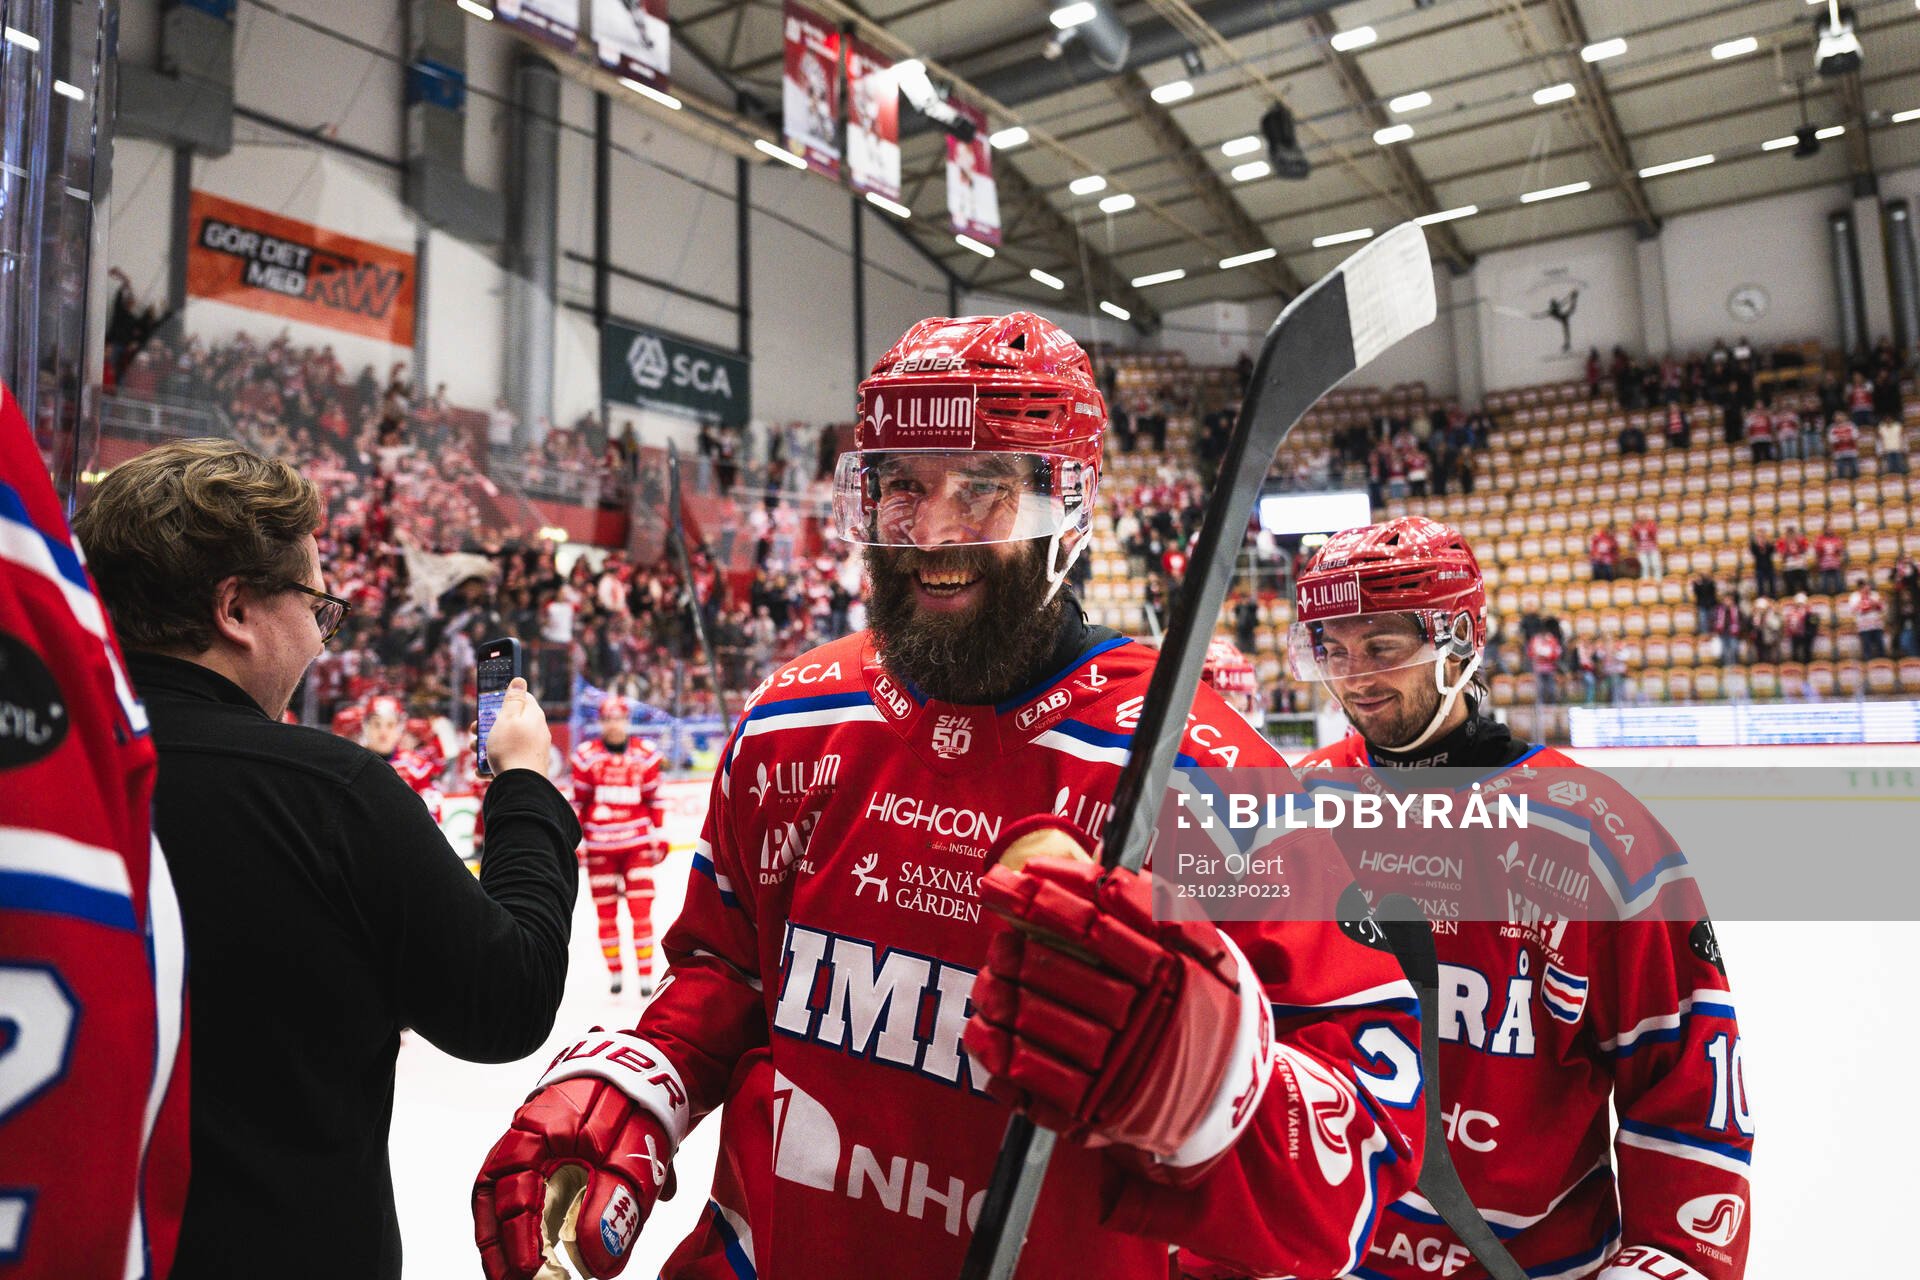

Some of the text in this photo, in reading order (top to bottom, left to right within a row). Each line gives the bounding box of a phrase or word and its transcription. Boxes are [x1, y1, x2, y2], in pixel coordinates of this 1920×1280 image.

[260, 237, 311, 269] DET
[246, 260, 306, 296] MED
[671, 353, 733, 399] SCA
[896, 396, 972, 429] LILIUM
[1312, 581, 1358, 606] LILIUM
[777, 661, 842, 688] SCA
[875, 676, 910, 717] EAB
[1019, 691, 1068, 729] EAB
[935, 714, 974, 731] SHL
[931, 727, 972, 755] 50
[865, 791, 1003, 844] HIGHCON
[1588, 797, 1636, 856] SCA
[1359, 850, 1463, 880] HIGHCON
[1425, 880, 1462, 892] INSTALCO
[895, 887, 983, 924] GÅRDEN
[774, 921, 994, 1096] IMR
[1706, 1033, 1755, 1136] 10
[1274, 1054, 1300, 1160] VENSK VÄRME
